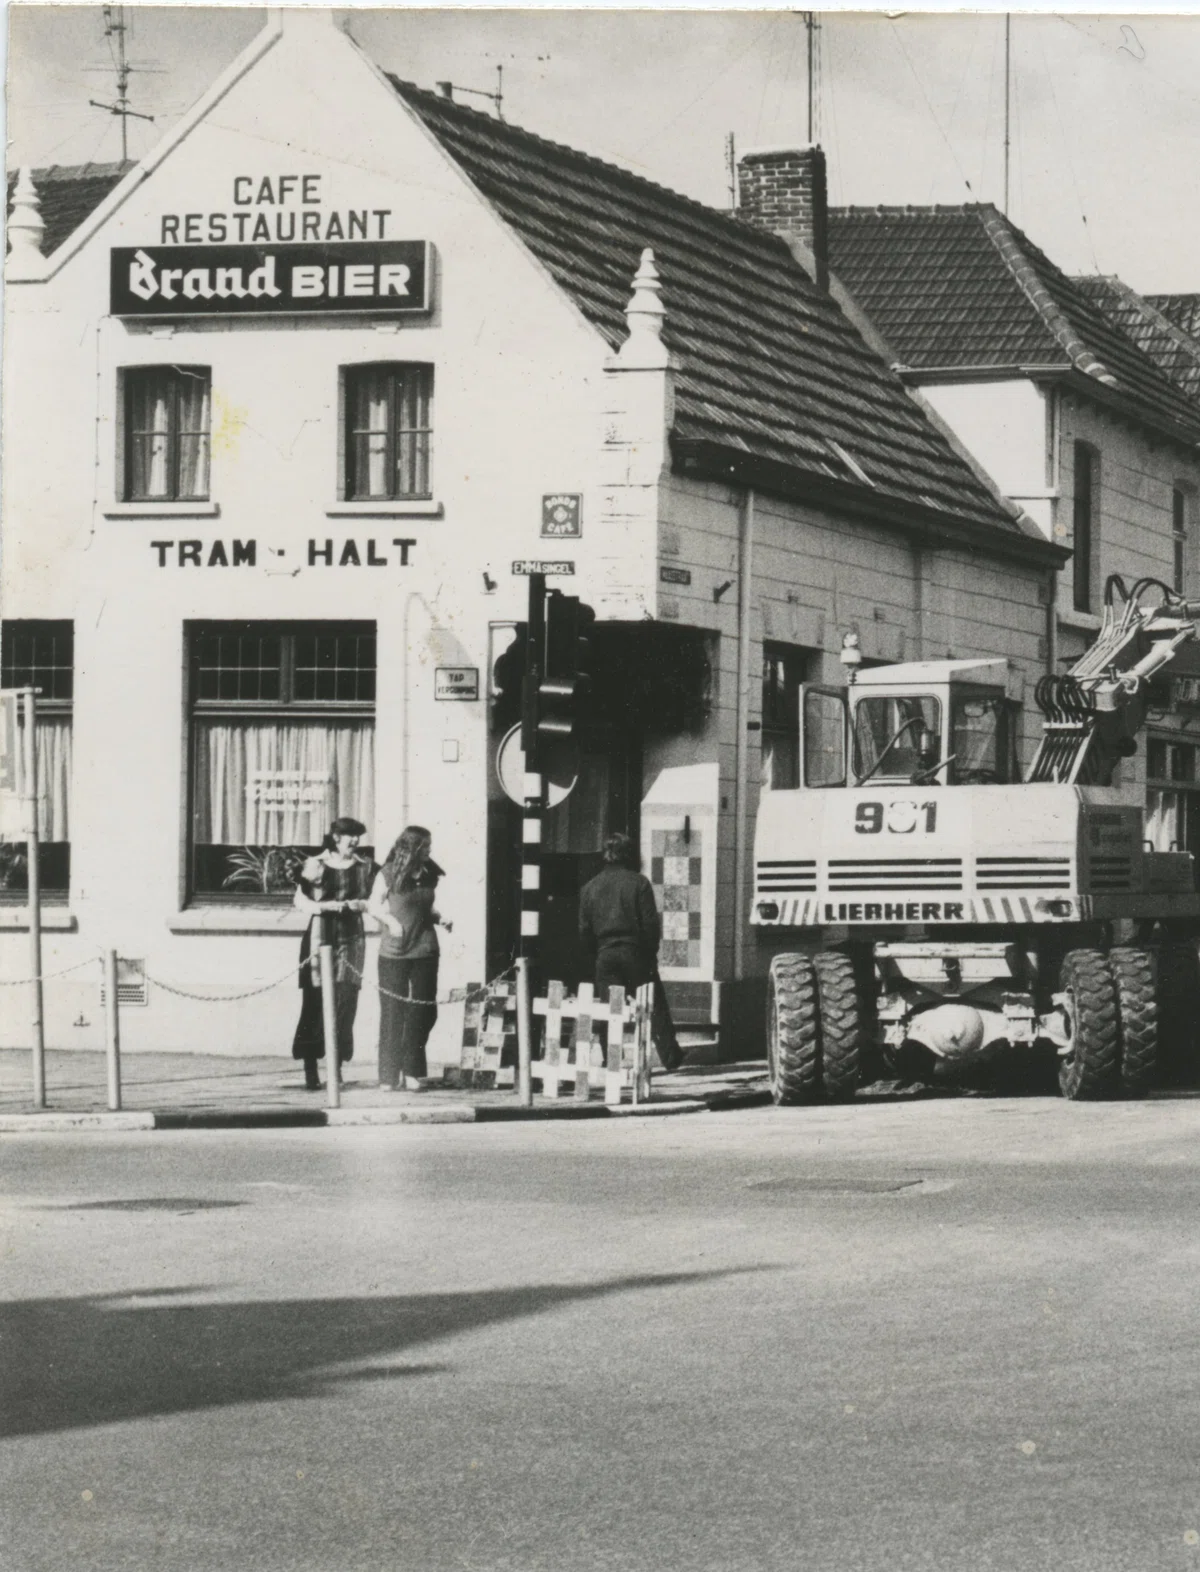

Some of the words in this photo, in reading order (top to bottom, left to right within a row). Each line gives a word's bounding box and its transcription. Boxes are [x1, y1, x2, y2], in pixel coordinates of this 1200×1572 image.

[234, 174, 322, 206] CAFE
[161, 209, 392, 245] RESTAURANT
[129, 249, 282, 301] Brand
[291, 263, 411, 298] BIER
[150, 539, 257, 568] TRAM
[307, 538, 417, 567] HALT
[514, 562, 572, 575] EMMASINGEL
[824, 902, 964, 921] LIEBHERR
